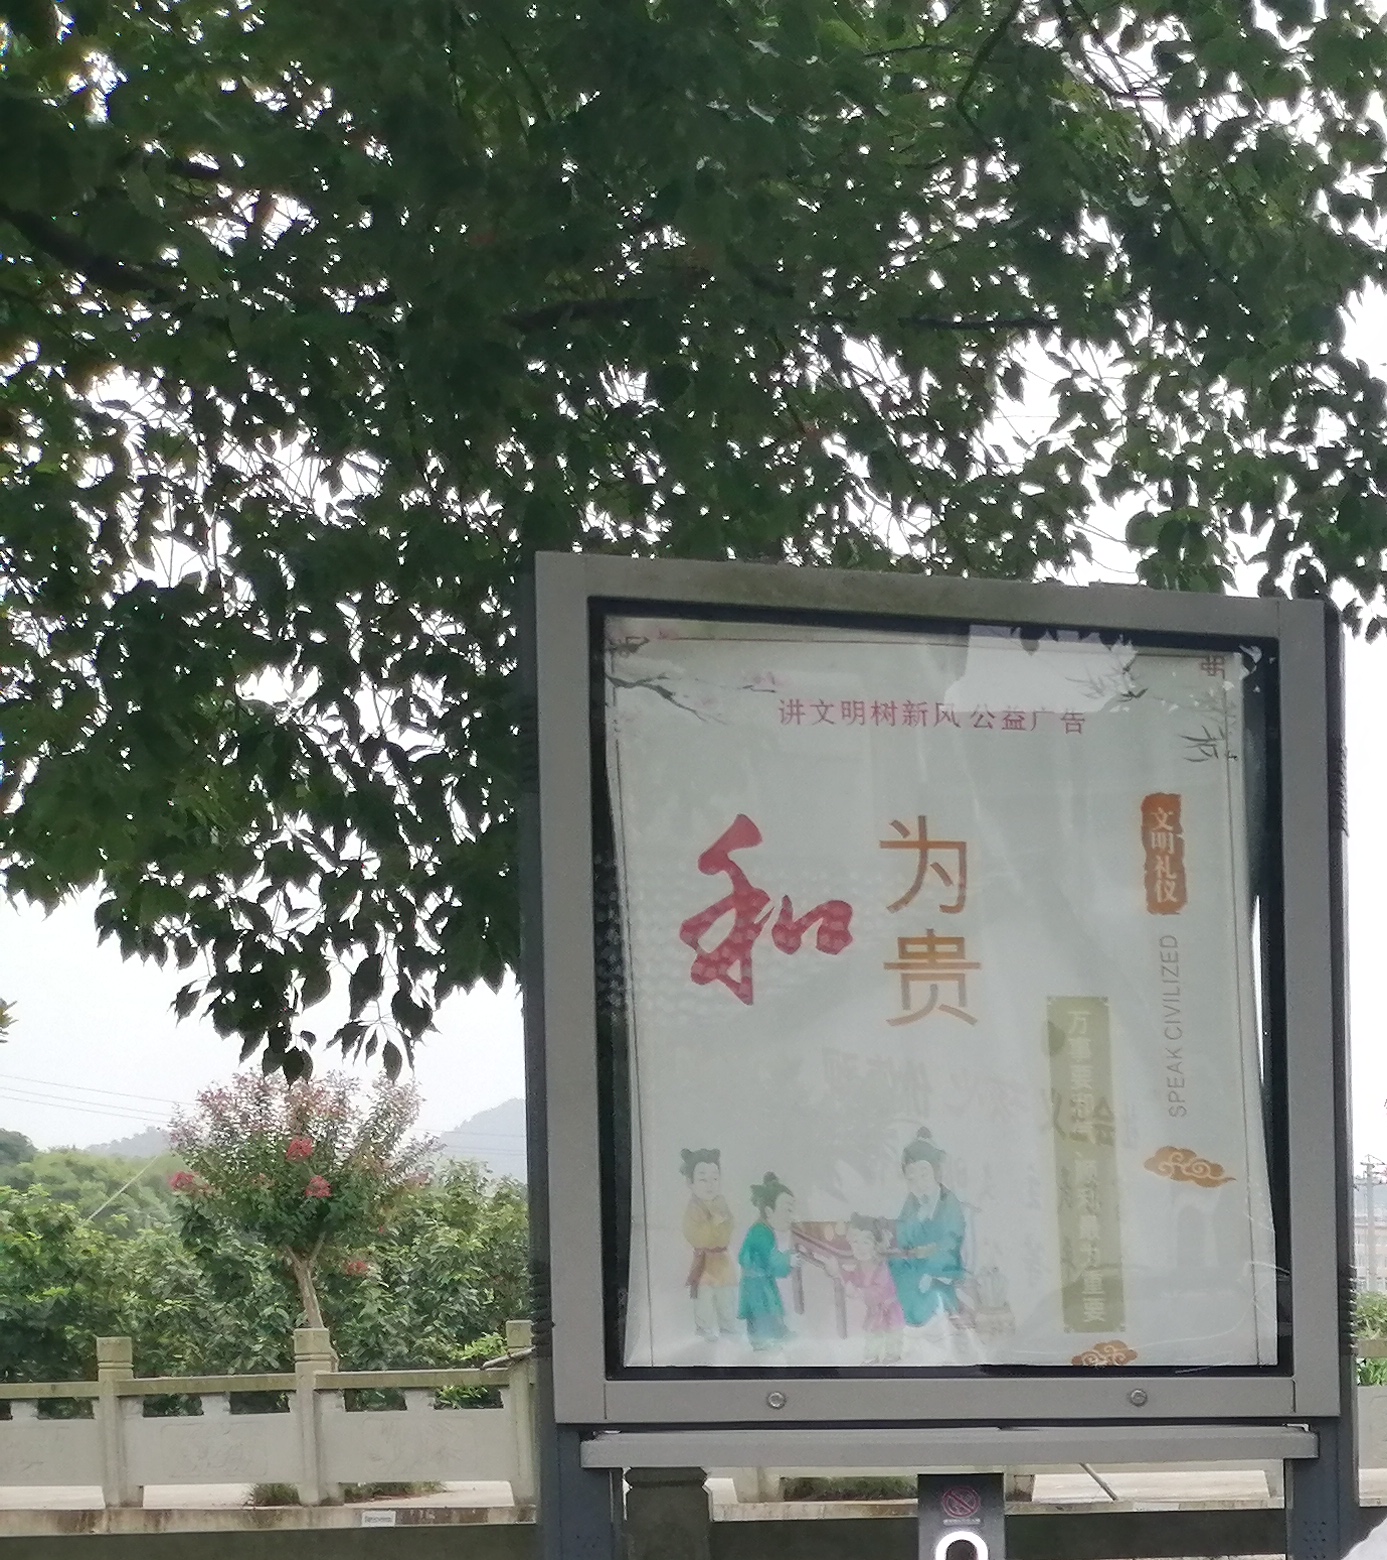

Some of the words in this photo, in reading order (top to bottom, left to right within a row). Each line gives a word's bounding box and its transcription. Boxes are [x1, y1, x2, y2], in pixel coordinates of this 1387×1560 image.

[778, 699, 961, 729] 讲文明树新风
[970, 703, 1087, 735] 公益广告
[1150, 806, 1179, 904] 文明礼仪
[879, 815, 982, 1027] 为贵
[1160, 934, 1183, 1041] CIVILIZED
[1168, 1046, 1187, 1118] SPEAK
